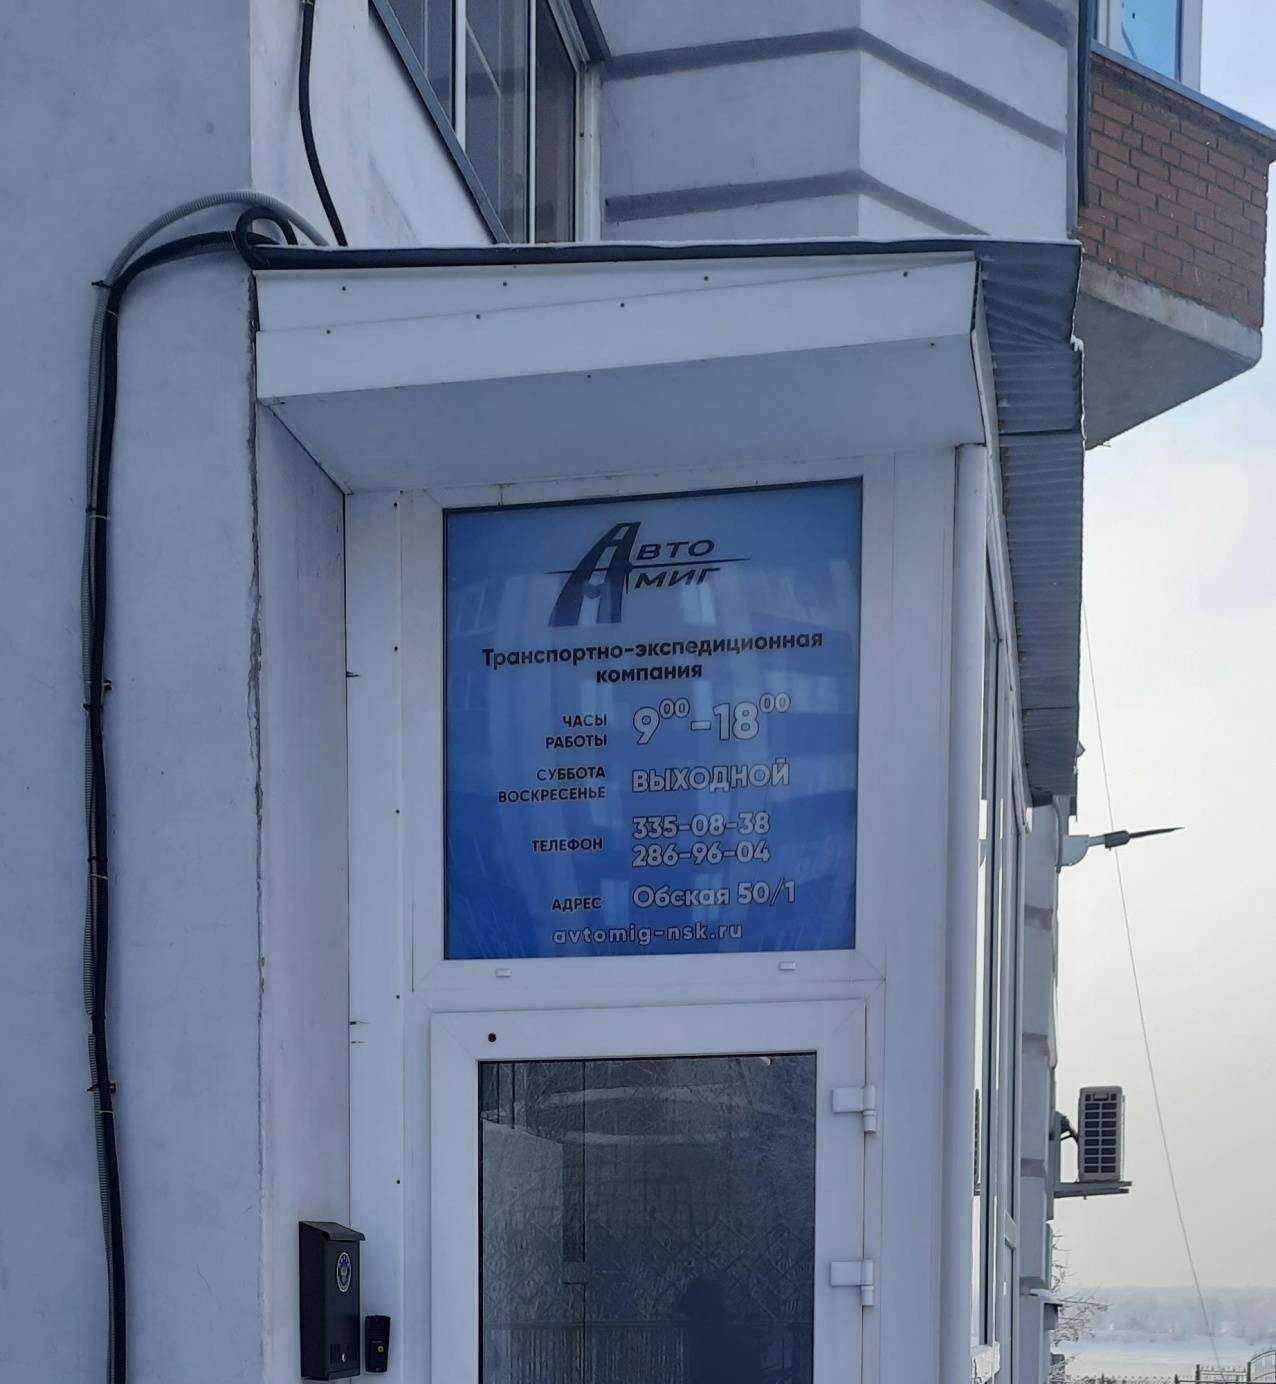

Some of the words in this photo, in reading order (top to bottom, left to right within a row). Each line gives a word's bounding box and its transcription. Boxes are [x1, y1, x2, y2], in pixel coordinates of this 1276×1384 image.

[634, 567, 721, 590] МИГ
[482, 632, 823, 671] Транспортно-экспедиционная
[596, 663, 703, 684] компания
[562, 713, 608, 728] ЧАСЫ
[545, 733, 608, 749] РАБОТЫ
[536, 765, 607, 781] СУББОТА
[631, 756, 790, 793] ВЫХОДНОЙ
[498, 785, 606, 803] ВОСКРЕСЕНЬЕ
[632, 811, 771, 840] 335-08-38
[531, 837, 603, 851] ТЕЛЕФОН
[632, 840, 771, 868] 286-96-04
[632, 881, 731, 908] Обская
[736, 877, 796, 907] 50/1
[552, 896, 602, 912] АДРЕС
[552, 923, 743, 946] avtomig-nsk.ru
